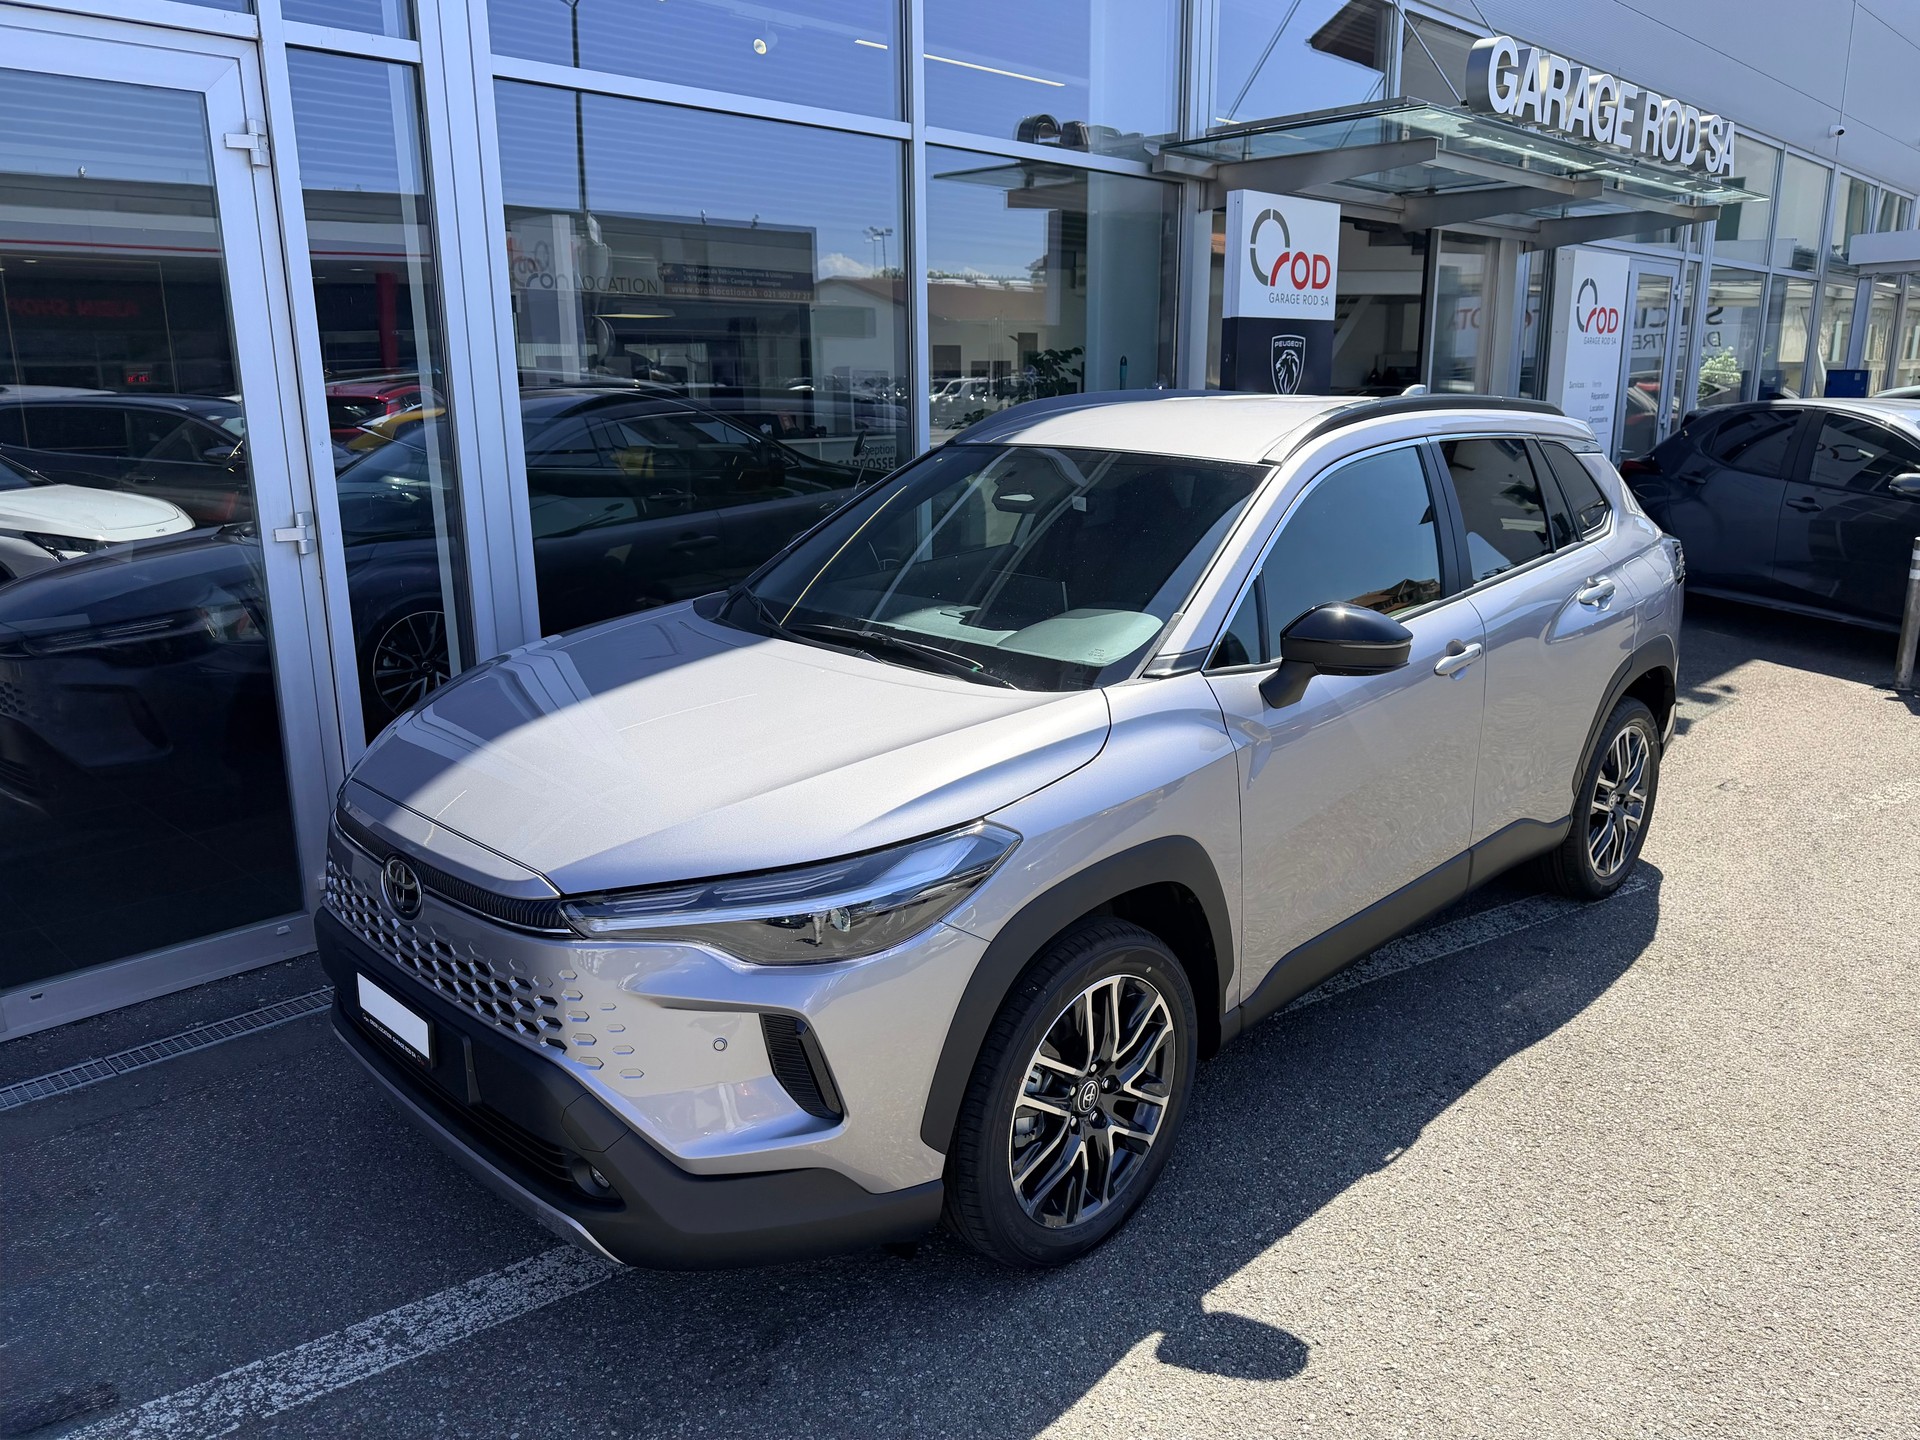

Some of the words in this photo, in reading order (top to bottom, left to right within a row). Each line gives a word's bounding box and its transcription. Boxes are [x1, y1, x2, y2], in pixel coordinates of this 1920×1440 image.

[1488, 35, 1638, 149] GARAGE
[1640, 90, 1700, 166] ROD
[1705, 114, 1735, 177] SA
[1269, 292, 1300, 305] GARAGE
[1302, 294, 1319, 306] ROD
[1320, 295, 1329, 306] SA
[1274, 340, 1303, 348] PEUGEOT
